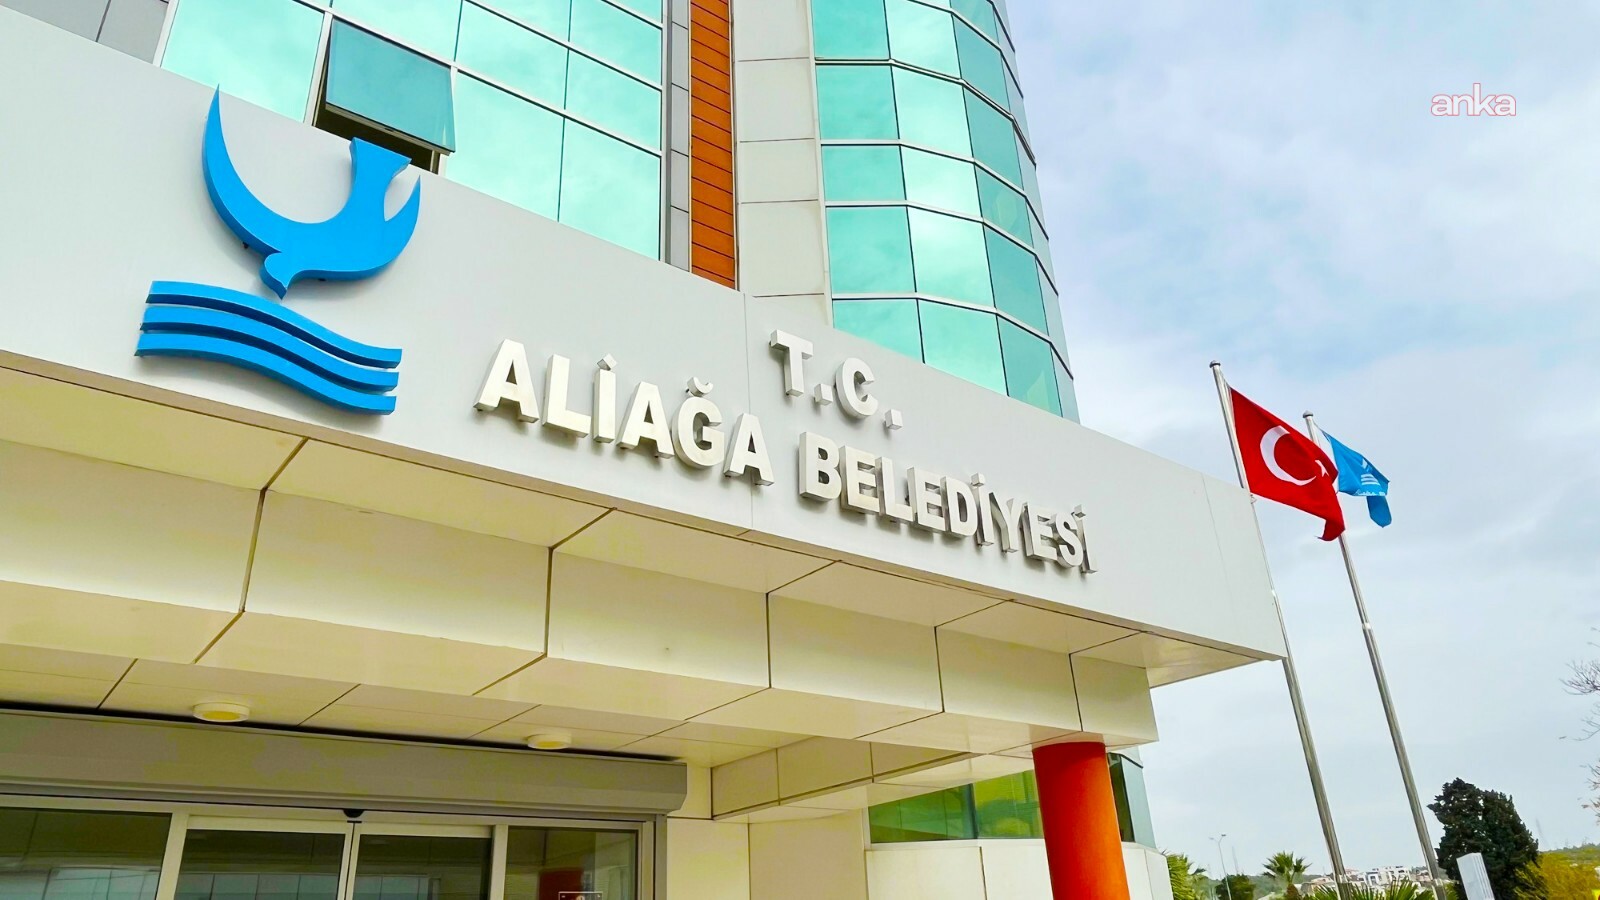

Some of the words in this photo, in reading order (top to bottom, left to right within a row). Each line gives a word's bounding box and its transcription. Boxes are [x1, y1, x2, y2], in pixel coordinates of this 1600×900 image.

[474, 339, 775, 486] ALİAĞA
[800, 431, 1098, 574] BELEDİYESİ
[769, 329, 903, 430] T.C.
